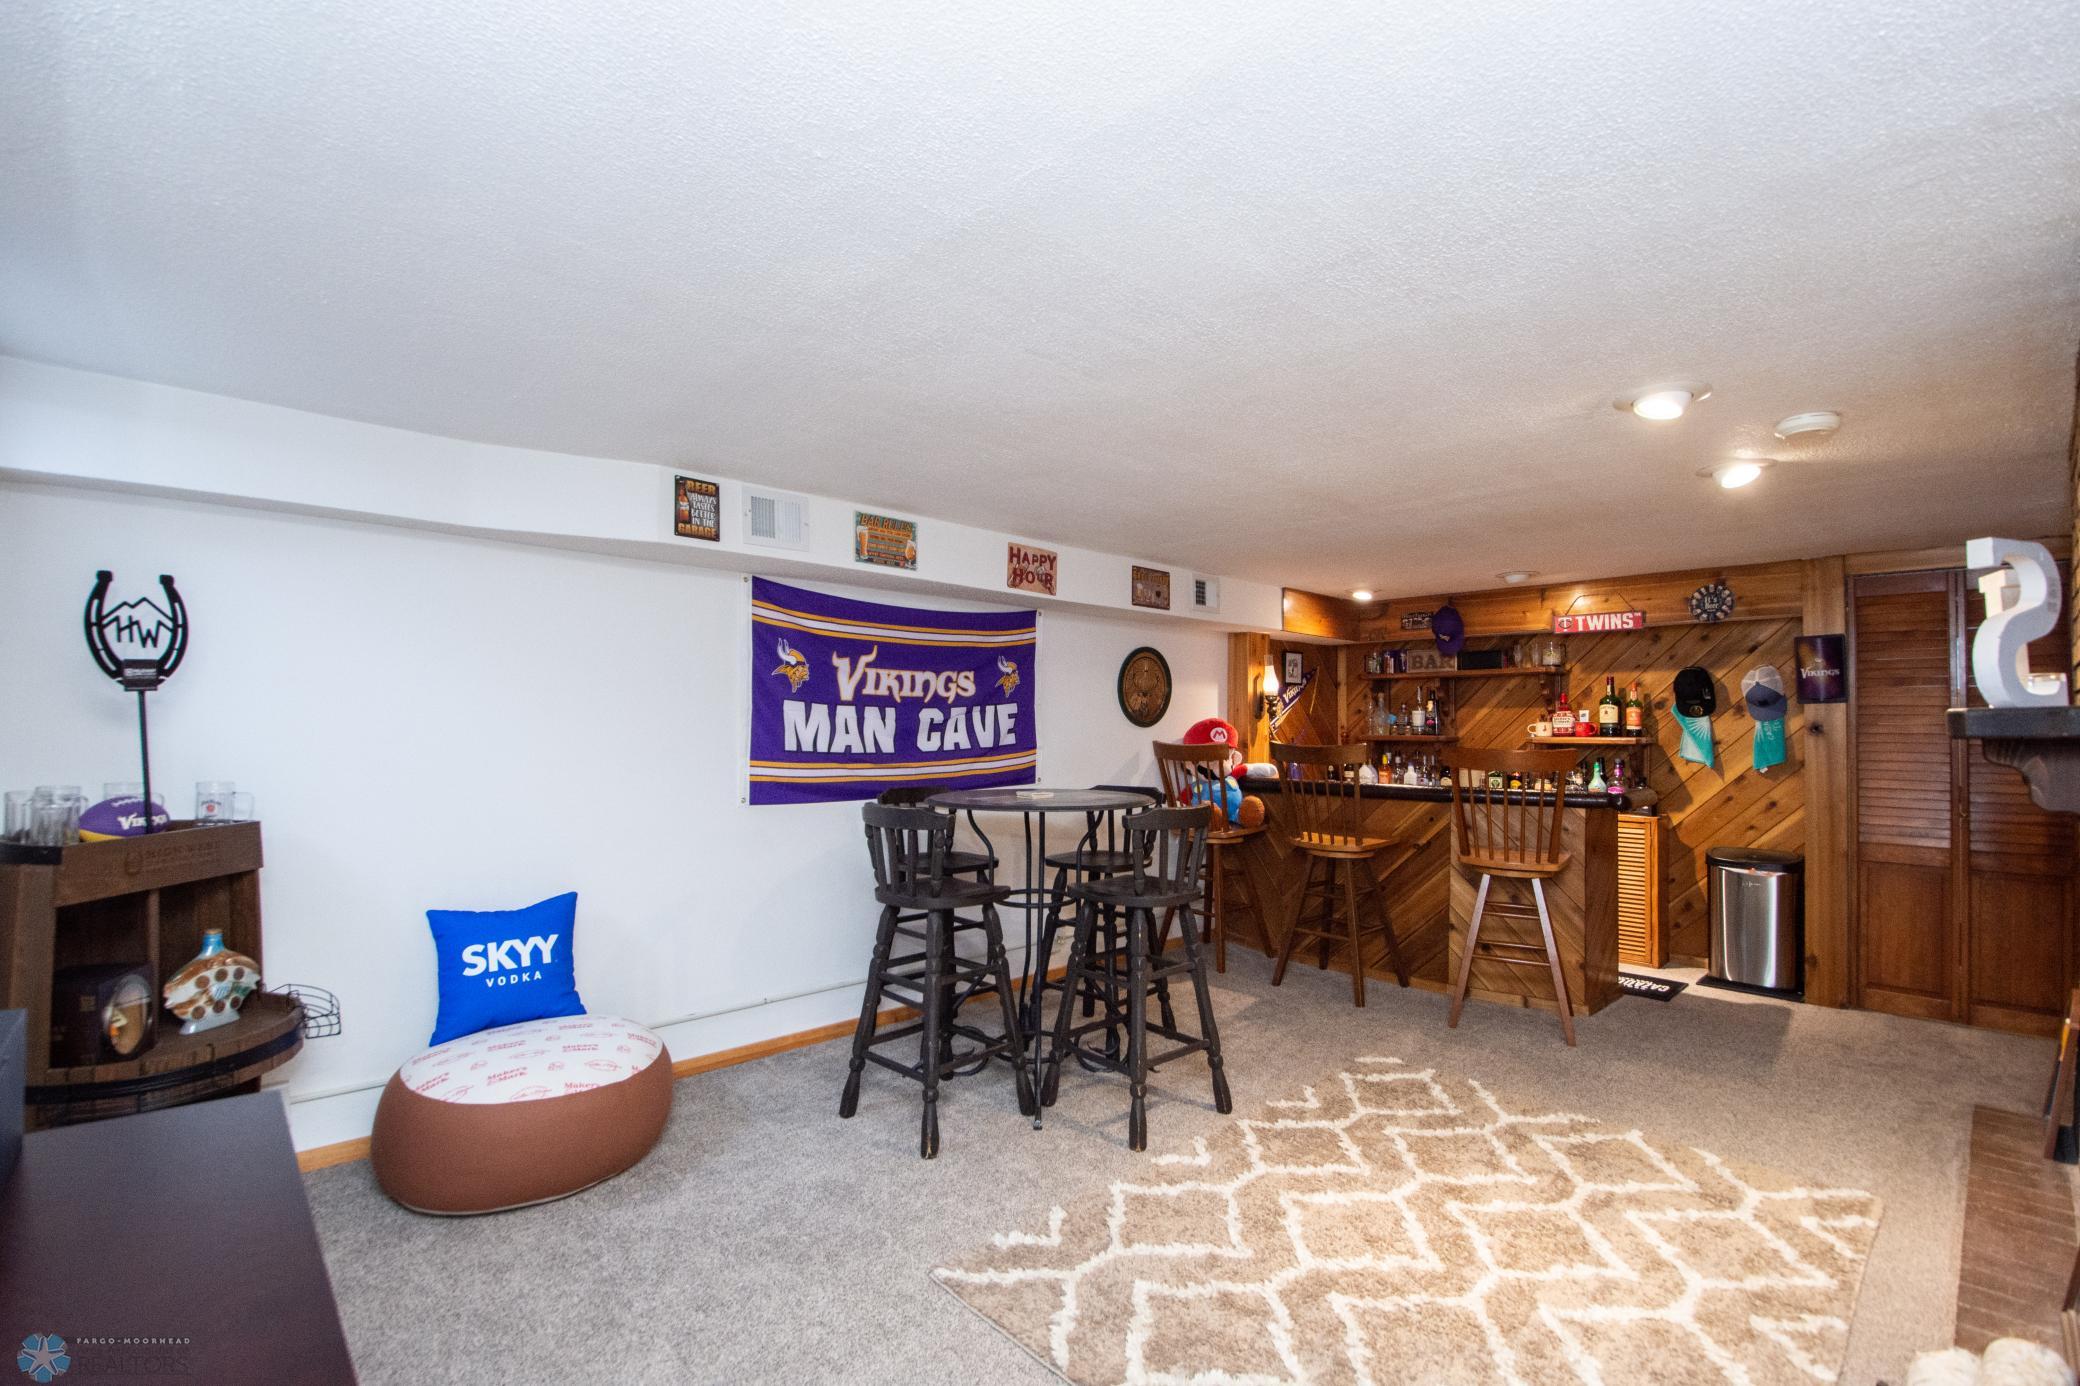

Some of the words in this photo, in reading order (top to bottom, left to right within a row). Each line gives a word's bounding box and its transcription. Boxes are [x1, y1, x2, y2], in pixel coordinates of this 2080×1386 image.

[686, 480, 716, 496] BEER
[678, 523, 717, 538] GARAGE
[1009, 546, 1057, 571] HAPPY
[1013, 567, 1054, 588] HOUR
[1575, 612, 1634, 632] TWINS
[832, 645, 976, 704] VIKINGS
[783, 699, 896, 753] MAN
[917, 703, 1018, 752] CAVE
[1213, 730, 1226, 740] M
[461, 933, 559, 977] SKYY
[486, 970, 542, 988] VODKA
